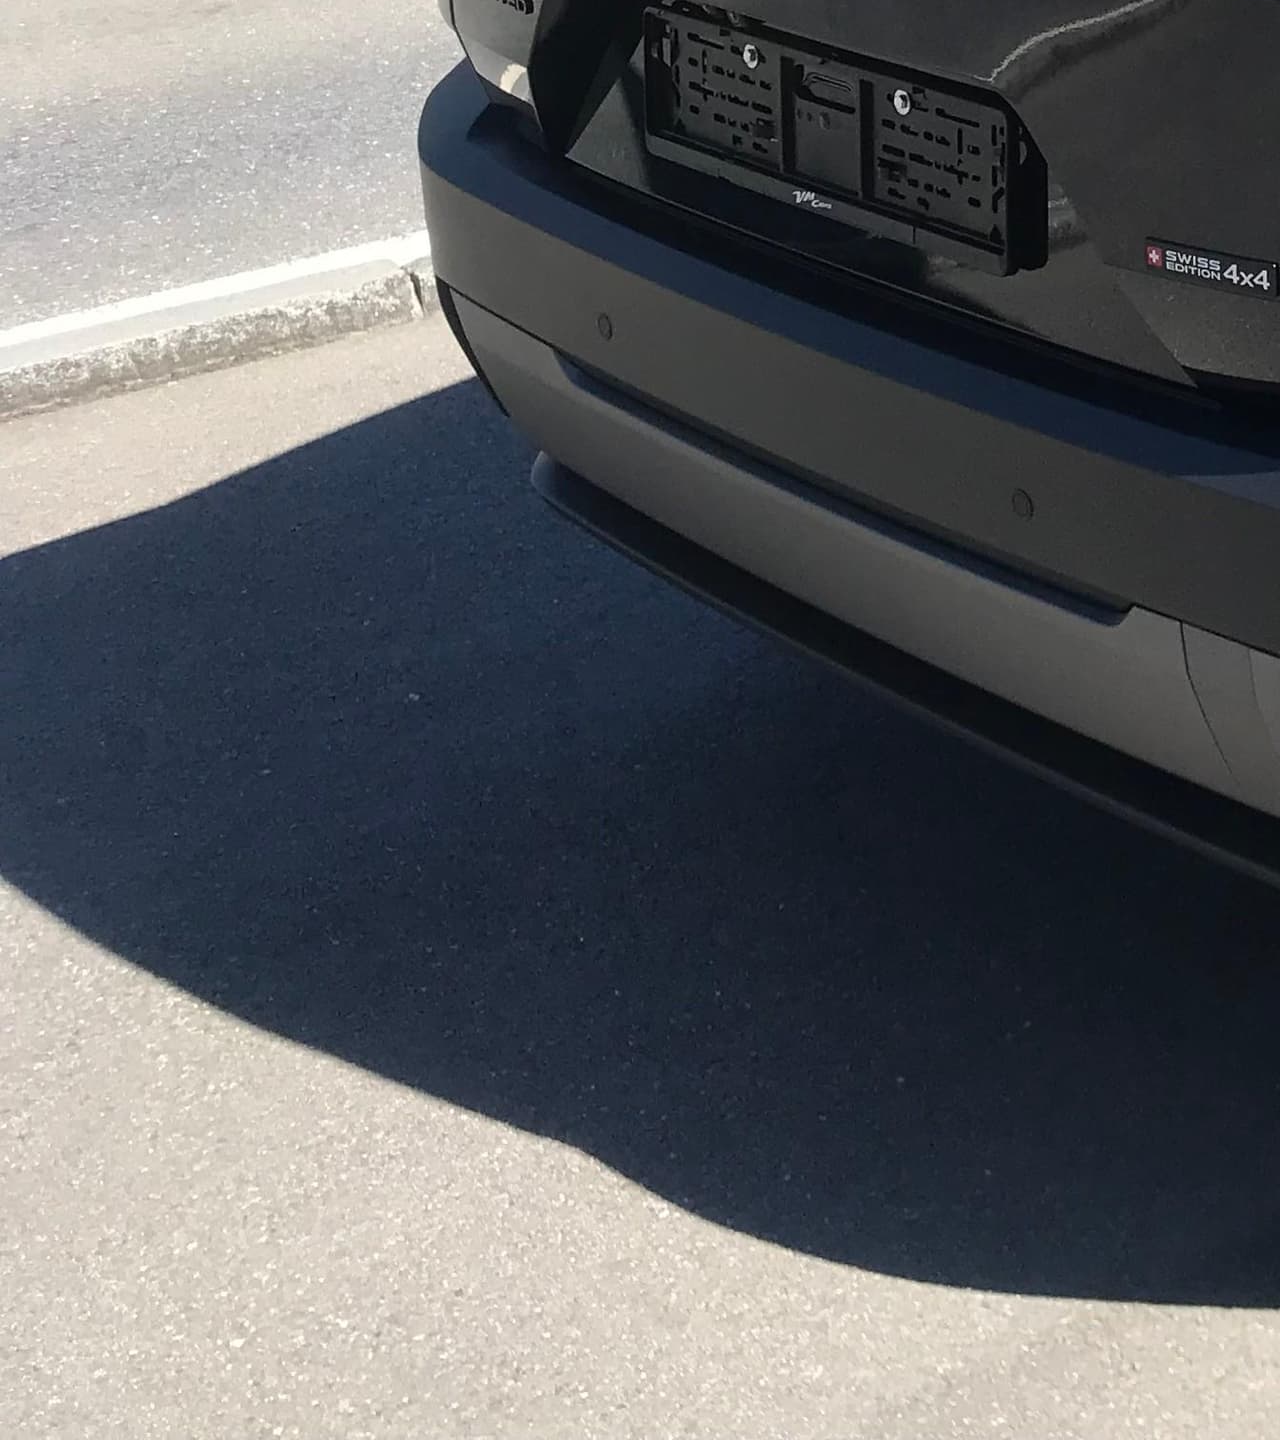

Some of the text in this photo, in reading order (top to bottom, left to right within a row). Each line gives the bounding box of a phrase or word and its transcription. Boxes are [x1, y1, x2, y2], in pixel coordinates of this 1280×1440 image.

[1165, 250, 1221, 272] SWISS
[1166, 261, 1221, 281] EDITION
[1223, 263, 1271, 290] 4x4
